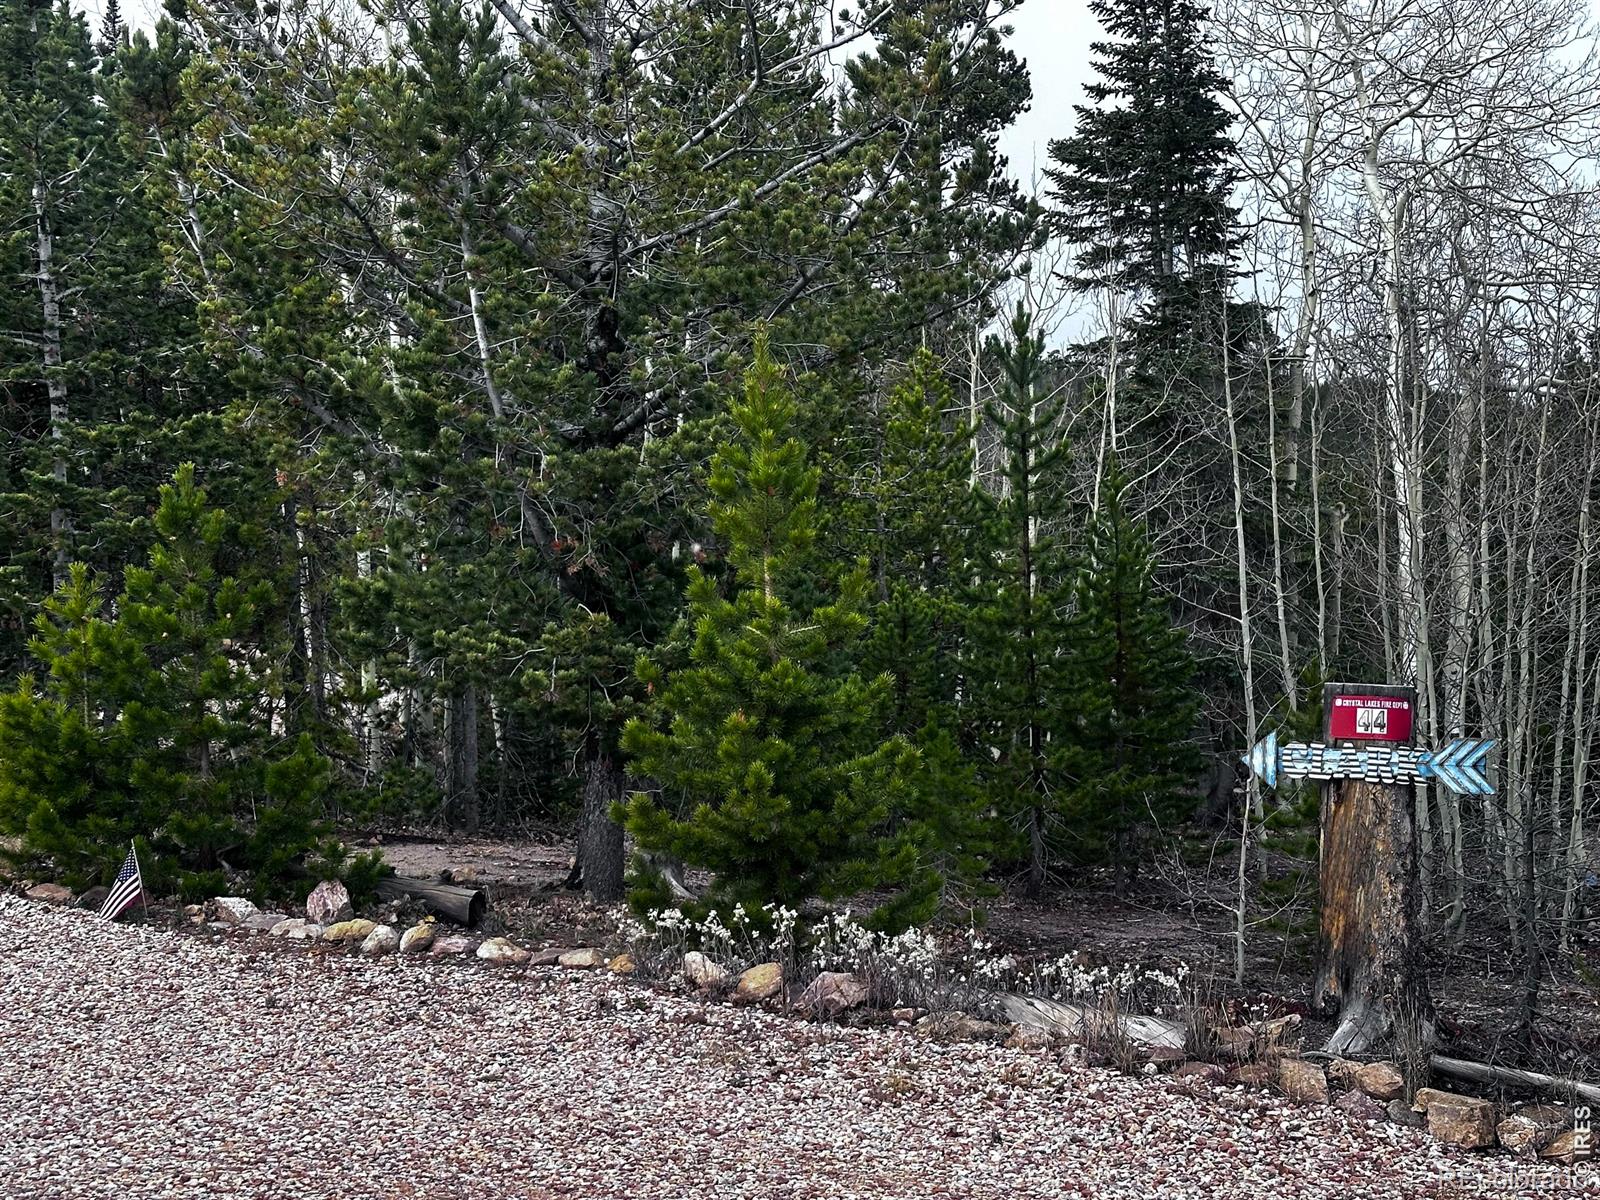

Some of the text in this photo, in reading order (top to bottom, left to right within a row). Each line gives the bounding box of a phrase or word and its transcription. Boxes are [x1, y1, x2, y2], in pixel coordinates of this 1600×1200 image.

[1342, 699, 1403, 709] CRYSTAL LAKES FIRE DEPT
[1357, 709, 1386, 732] 44
[1282, 741, 1428, 786] CLARK
